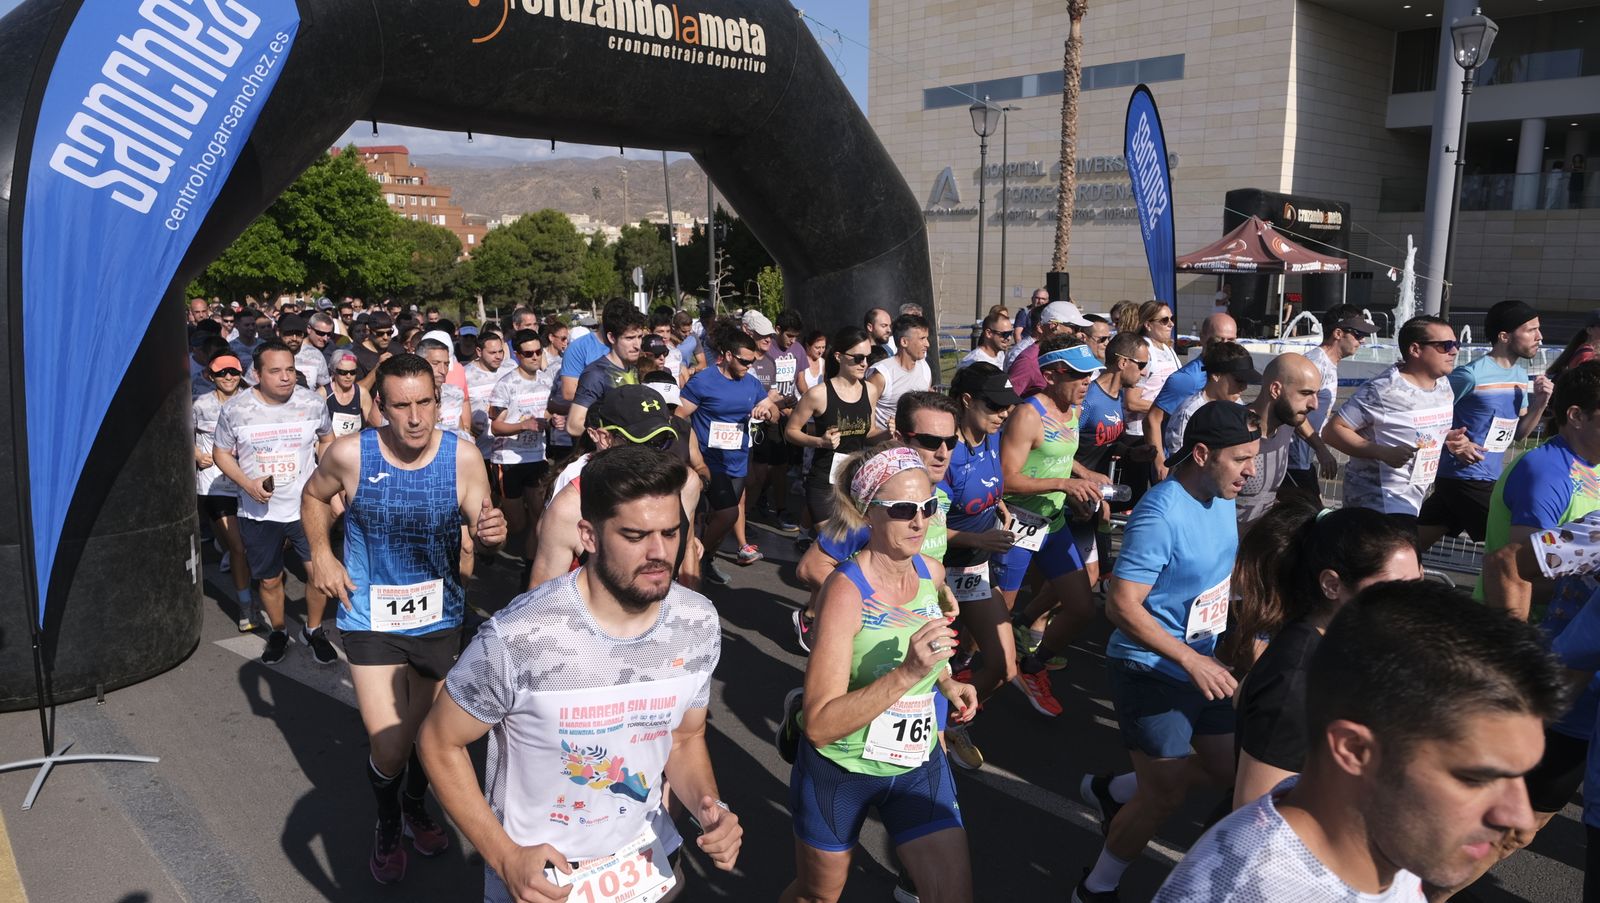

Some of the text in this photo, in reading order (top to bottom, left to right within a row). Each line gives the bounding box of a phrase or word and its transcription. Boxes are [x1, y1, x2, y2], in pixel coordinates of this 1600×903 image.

[608, 35, 767, 74] cronometraje deportivo
[164, 31, 290, 231] centrohogarsanchez.es
[342, 422, 354, 430] 51
[714, 431, 740, 440] 1027
[259, 463, 296, 473] 1139
[955, 575, 982, 589] 169
[386, 596, 428, 615] 141
[572, 702, 625, 720] CARRERA
[627, 699, 647, 712] SIN
[650, 695, 677, 711] HUMO
[892, 717, 931, 742] 165
[577, 847, 653, 903] 1037
